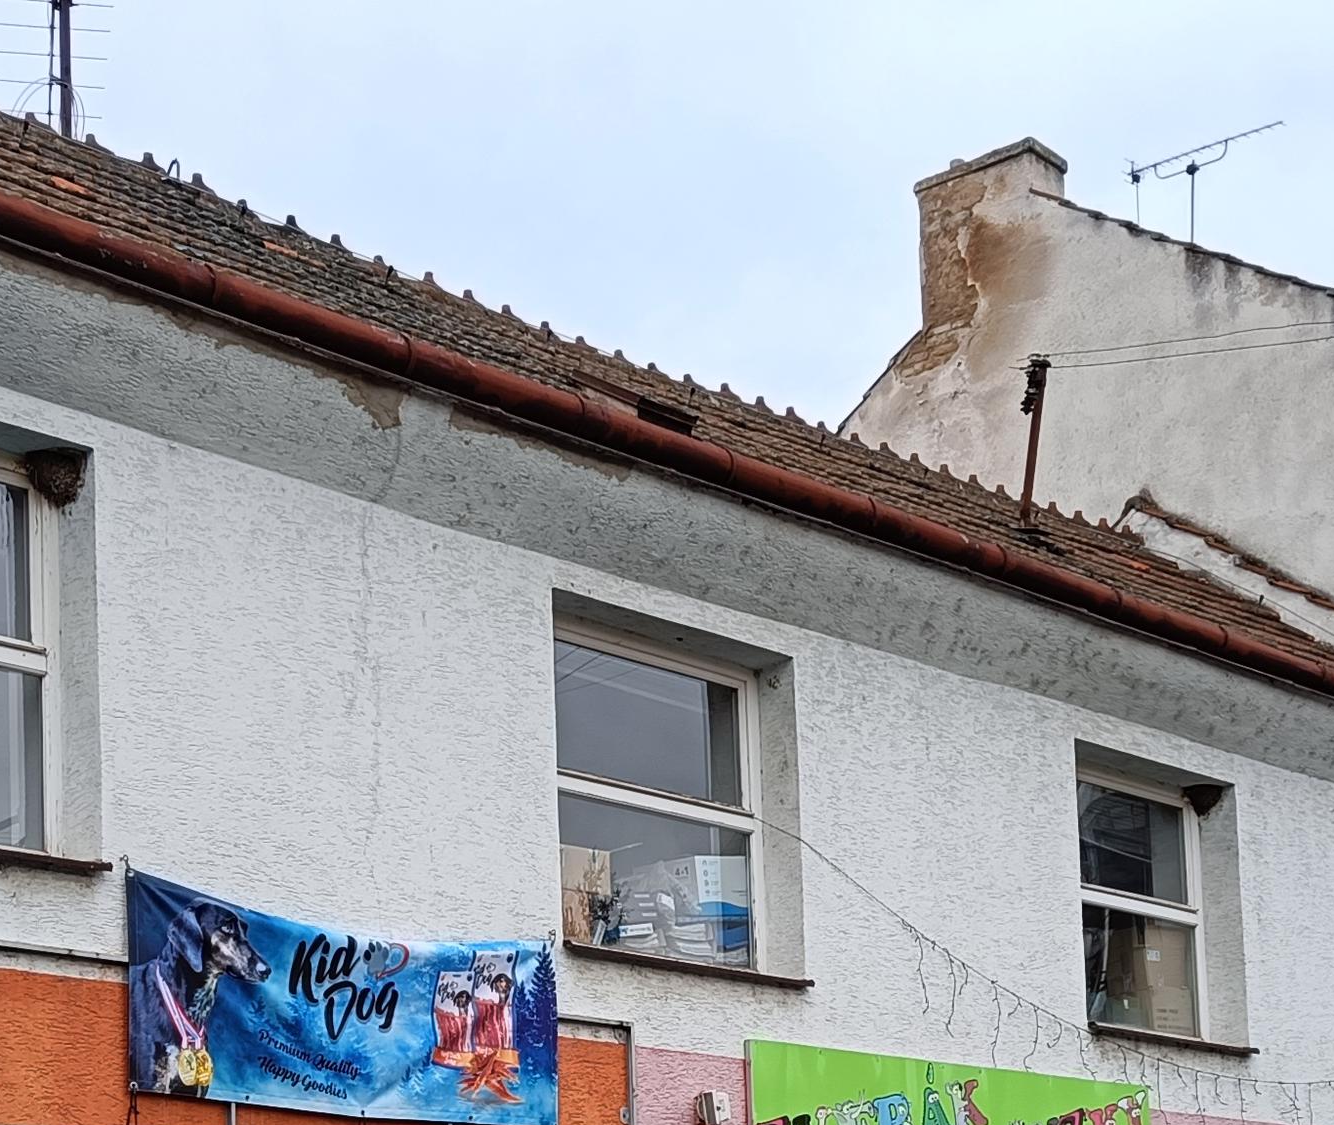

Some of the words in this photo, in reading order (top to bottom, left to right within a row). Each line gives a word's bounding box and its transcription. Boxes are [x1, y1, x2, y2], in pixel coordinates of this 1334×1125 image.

[288, 932, 361, 1004] Kid
[322, 980, 399, 1041] Dog
[257, 1028, 313, 1063] Premium
[312, 1053, 361, 1081] Quality
[257, 1055, 301, 1088] Happy
[301, 1074, 348, 1100] Goodies
